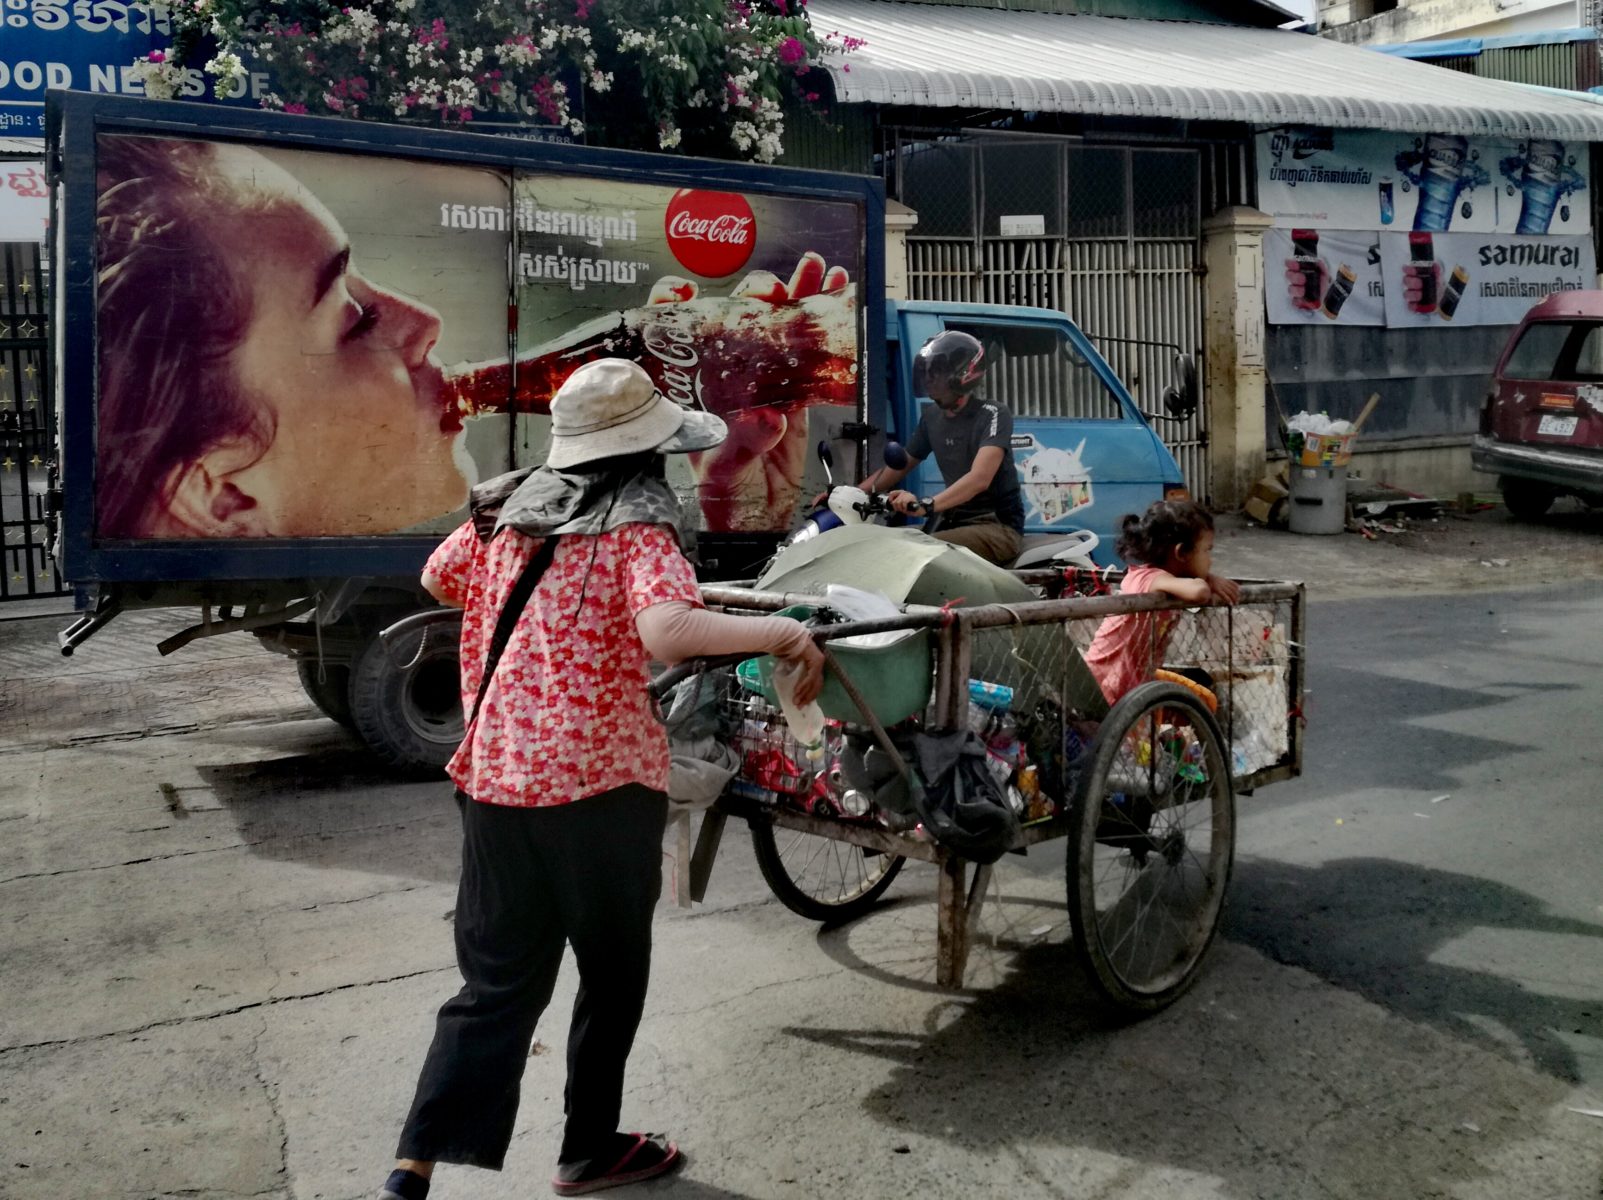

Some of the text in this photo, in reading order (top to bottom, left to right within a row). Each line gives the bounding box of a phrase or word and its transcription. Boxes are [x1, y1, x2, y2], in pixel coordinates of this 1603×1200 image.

[90, 64, 206, 97] NES
[669, 211, 752, 244] Coca-Cola
[1478, 243, 1580, 269] samurai
